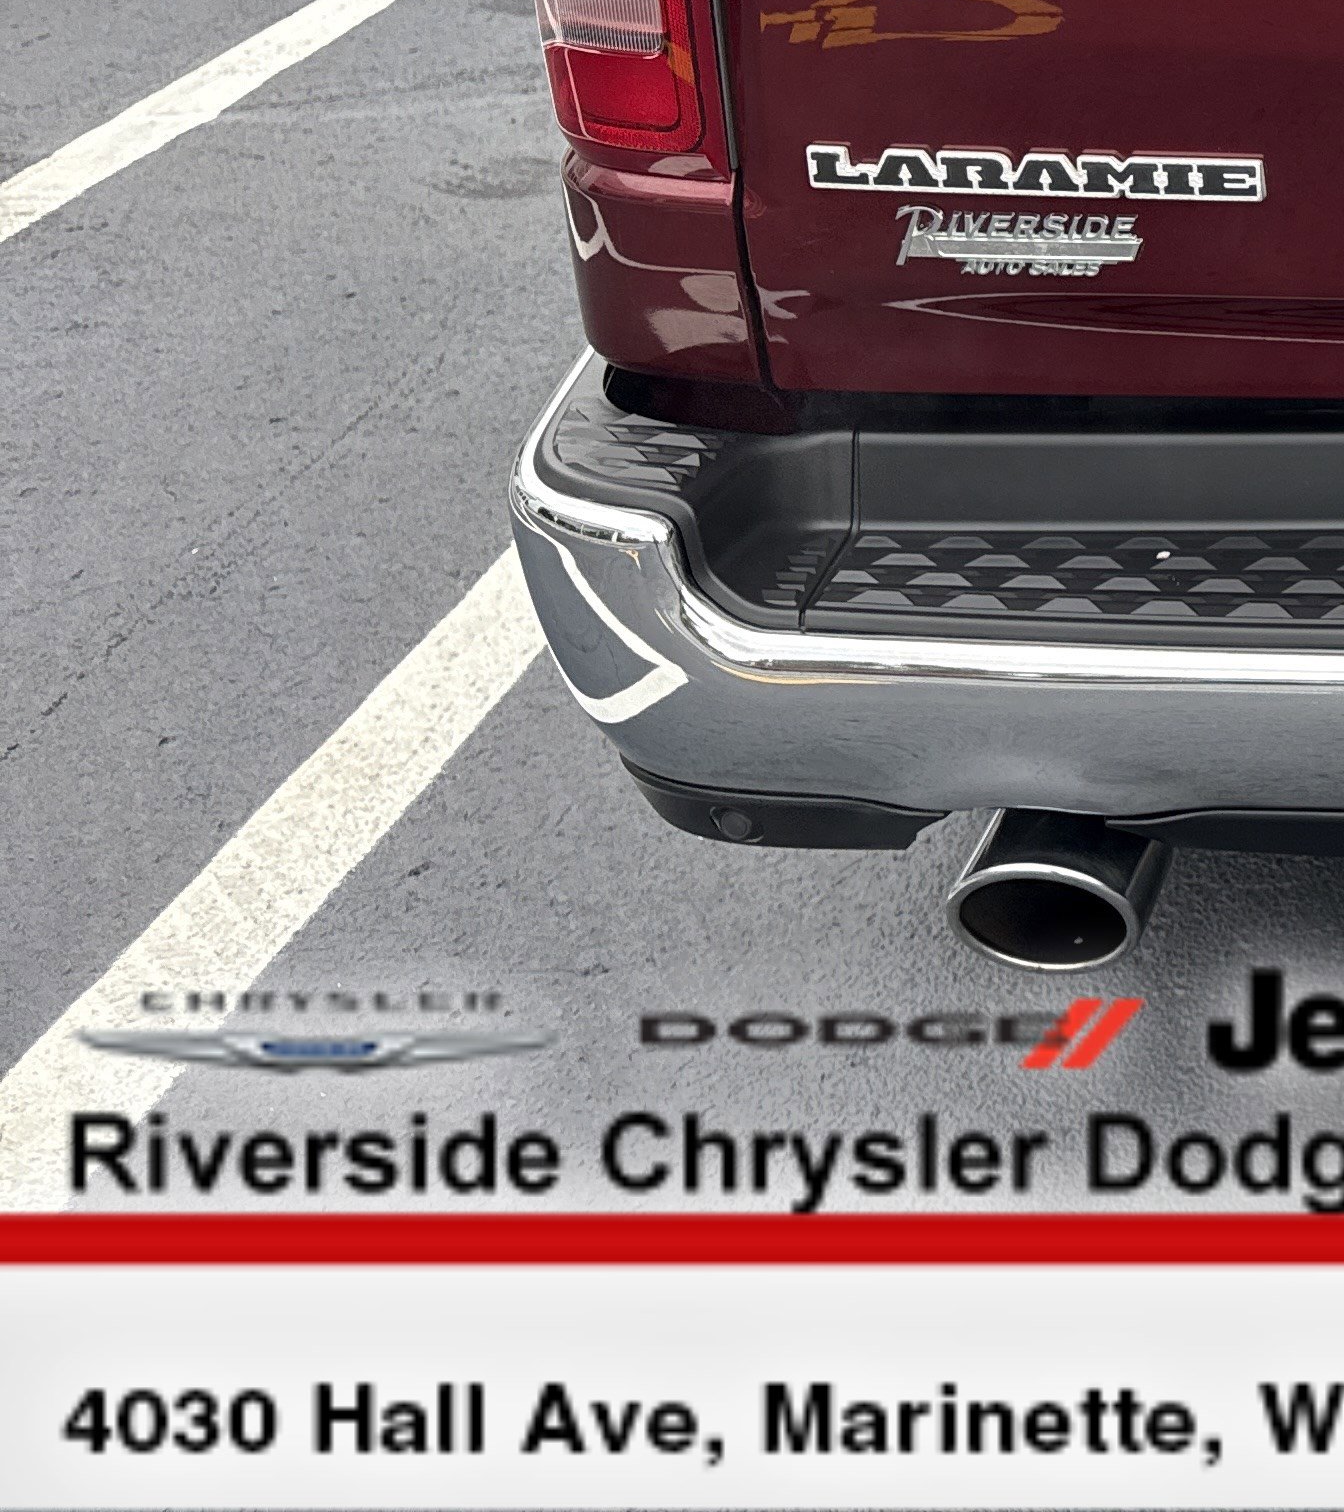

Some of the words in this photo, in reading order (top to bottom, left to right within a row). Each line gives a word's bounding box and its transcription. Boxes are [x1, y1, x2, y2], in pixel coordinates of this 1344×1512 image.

[806, 144, 1267, 202] LARAMIE
[895, 204, 1140, 266] RIVERSIDE
[961, 258, 1025, 276] AUTO
[1028, 260, 1103, 277] SALES
